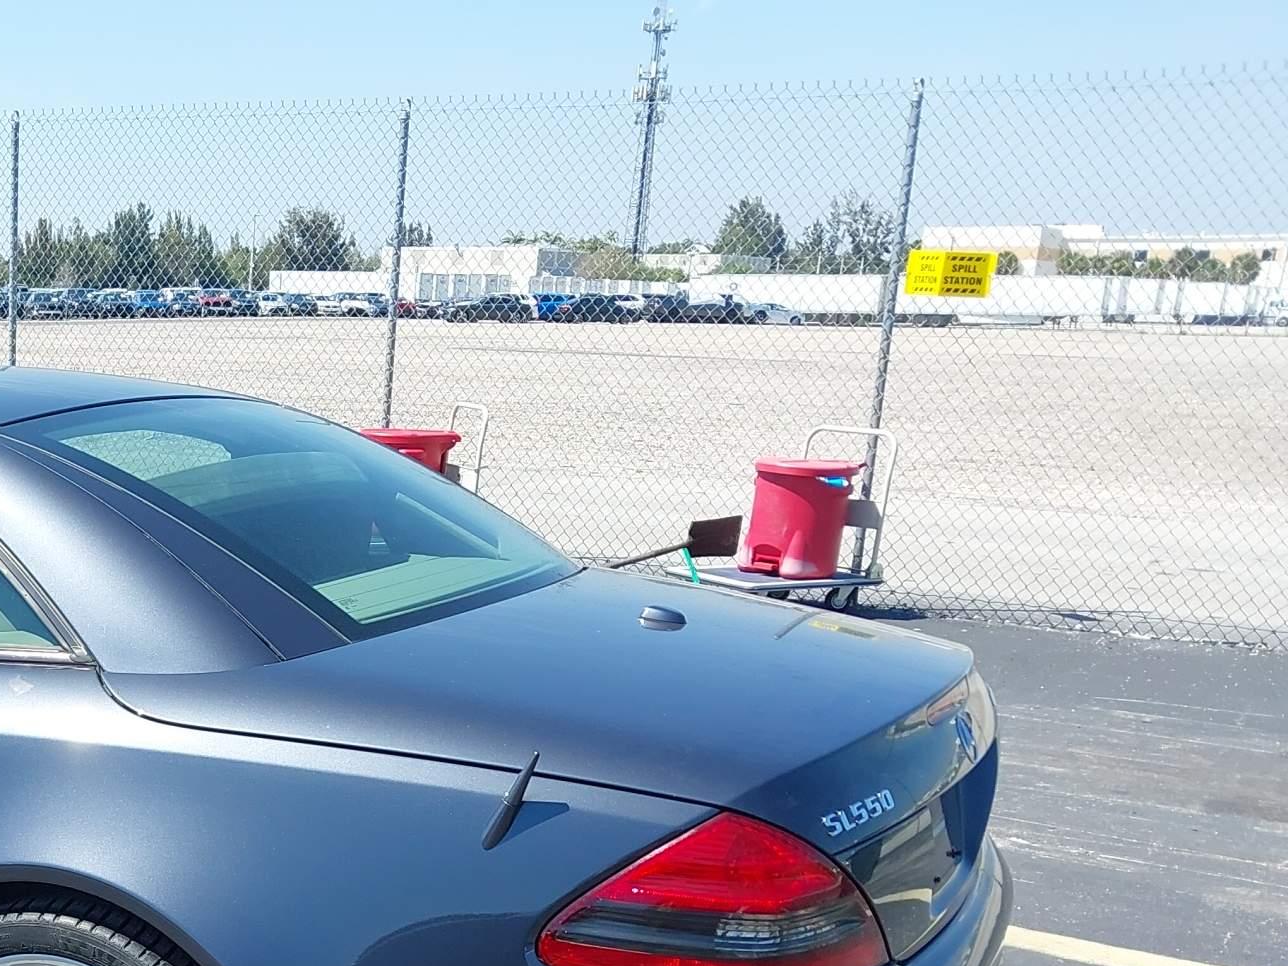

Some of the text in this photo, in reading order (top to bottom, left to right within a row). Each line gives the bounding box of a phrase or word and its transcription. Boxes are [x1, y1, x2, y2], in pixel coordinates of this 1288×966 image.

[920, 263, 937, 272] SPILL
[951, 264, 978, 273] SPILL
[914, 276, 937, 284] STATION
[943, 276, 983, 285] STATION
[821, 788, 896, 837] SL550
